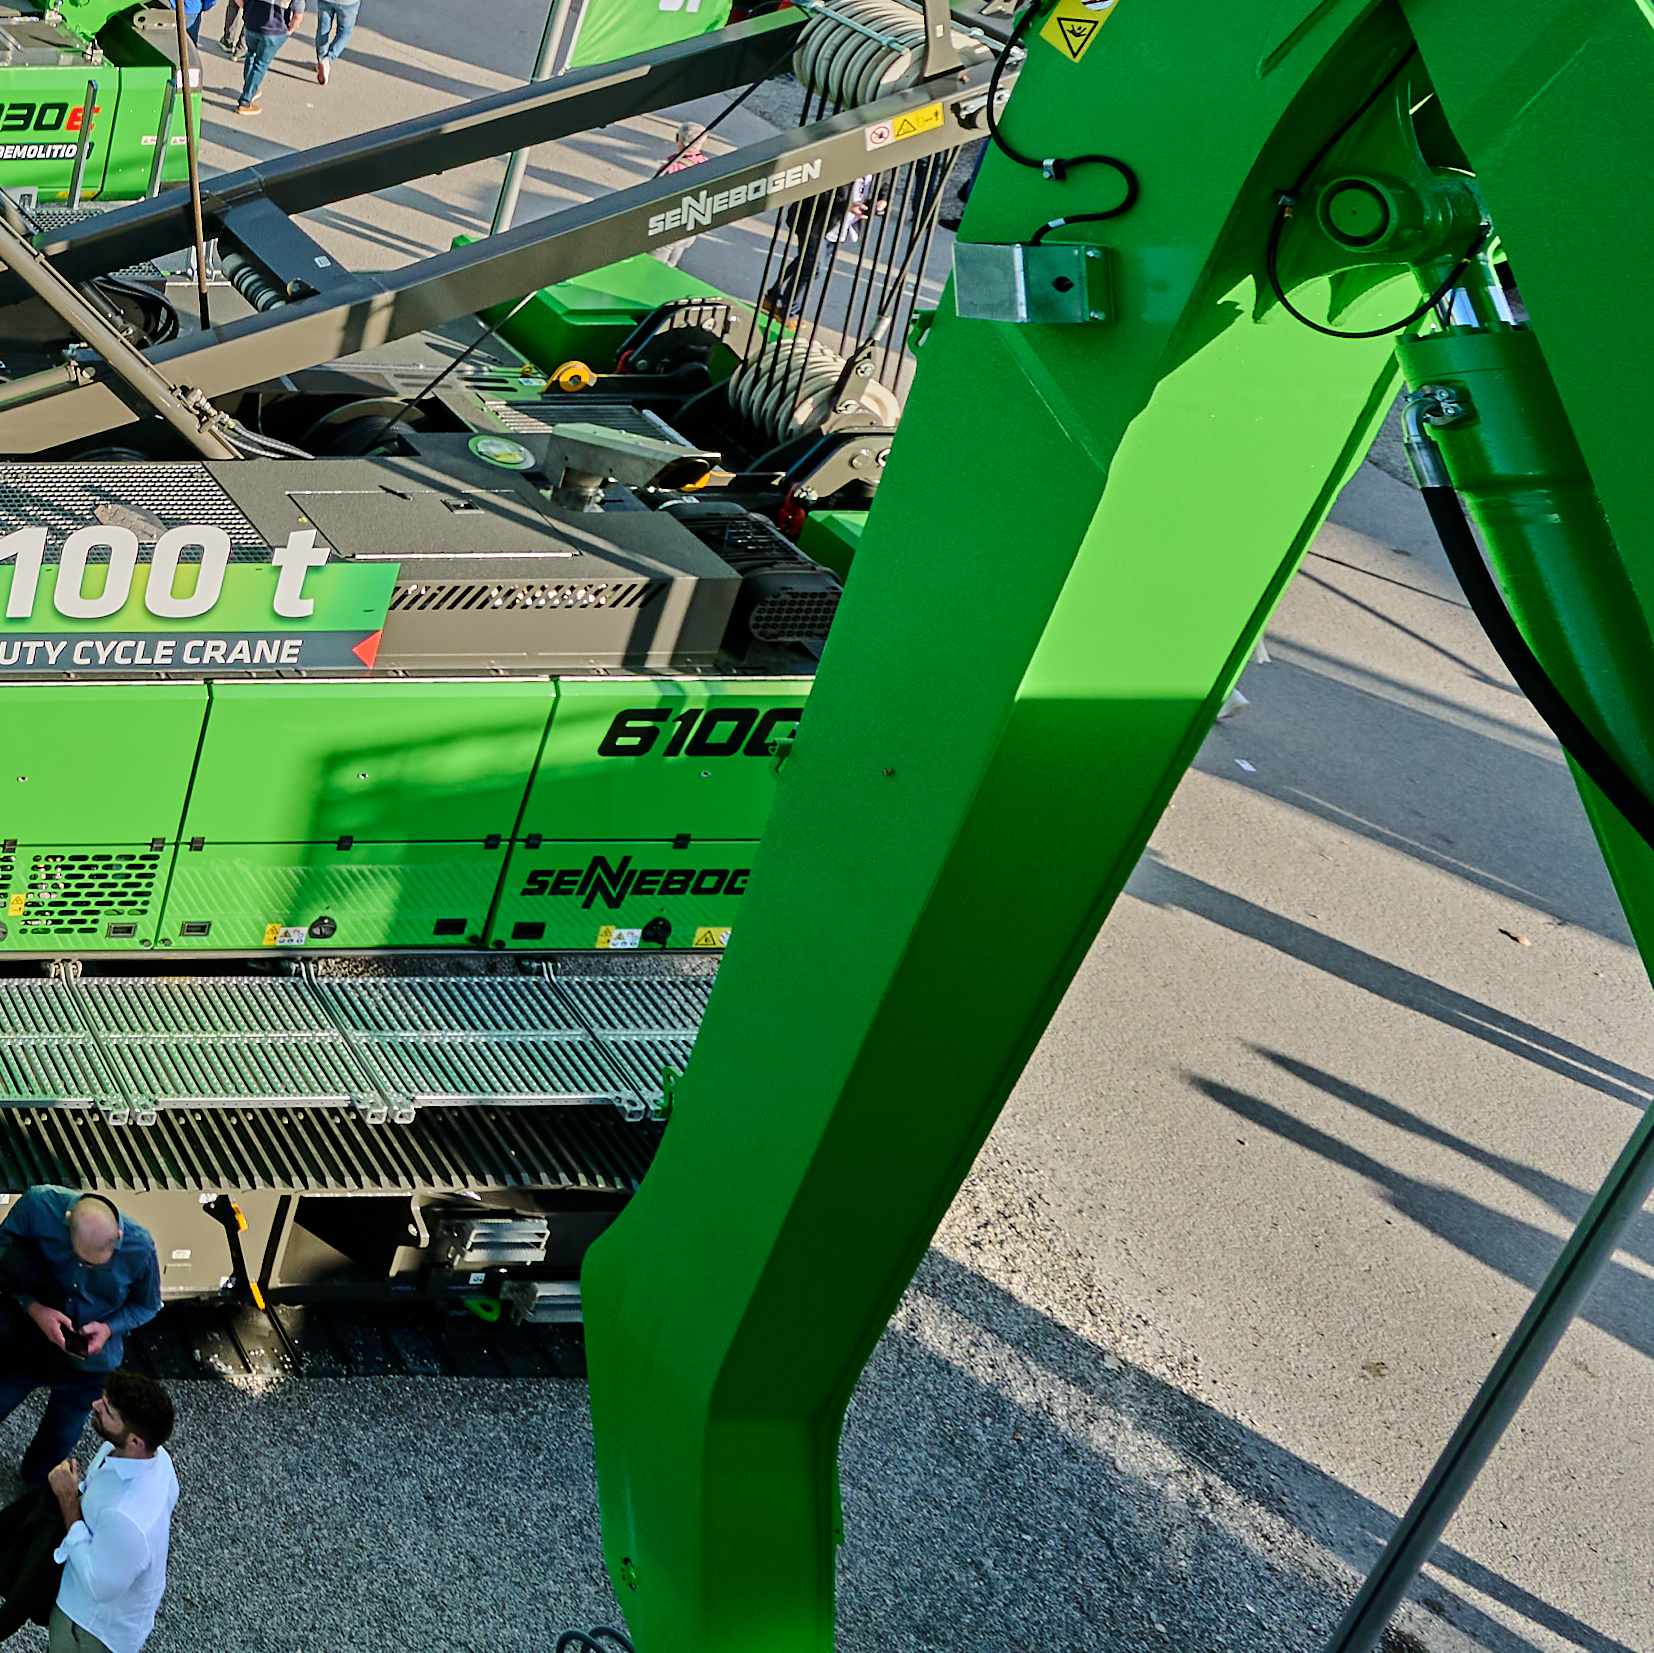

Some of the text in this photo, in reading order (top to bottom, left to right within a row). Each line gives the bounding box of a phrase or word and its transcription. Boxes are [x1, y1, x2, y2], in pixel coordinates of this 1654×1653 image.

[647, 158, 823, 238] SENNEBOGEN
[271, 528, 334, 619] t
[71, 640, 175, 666] CYCLE
[180, 638, 302, 665] CRANE
